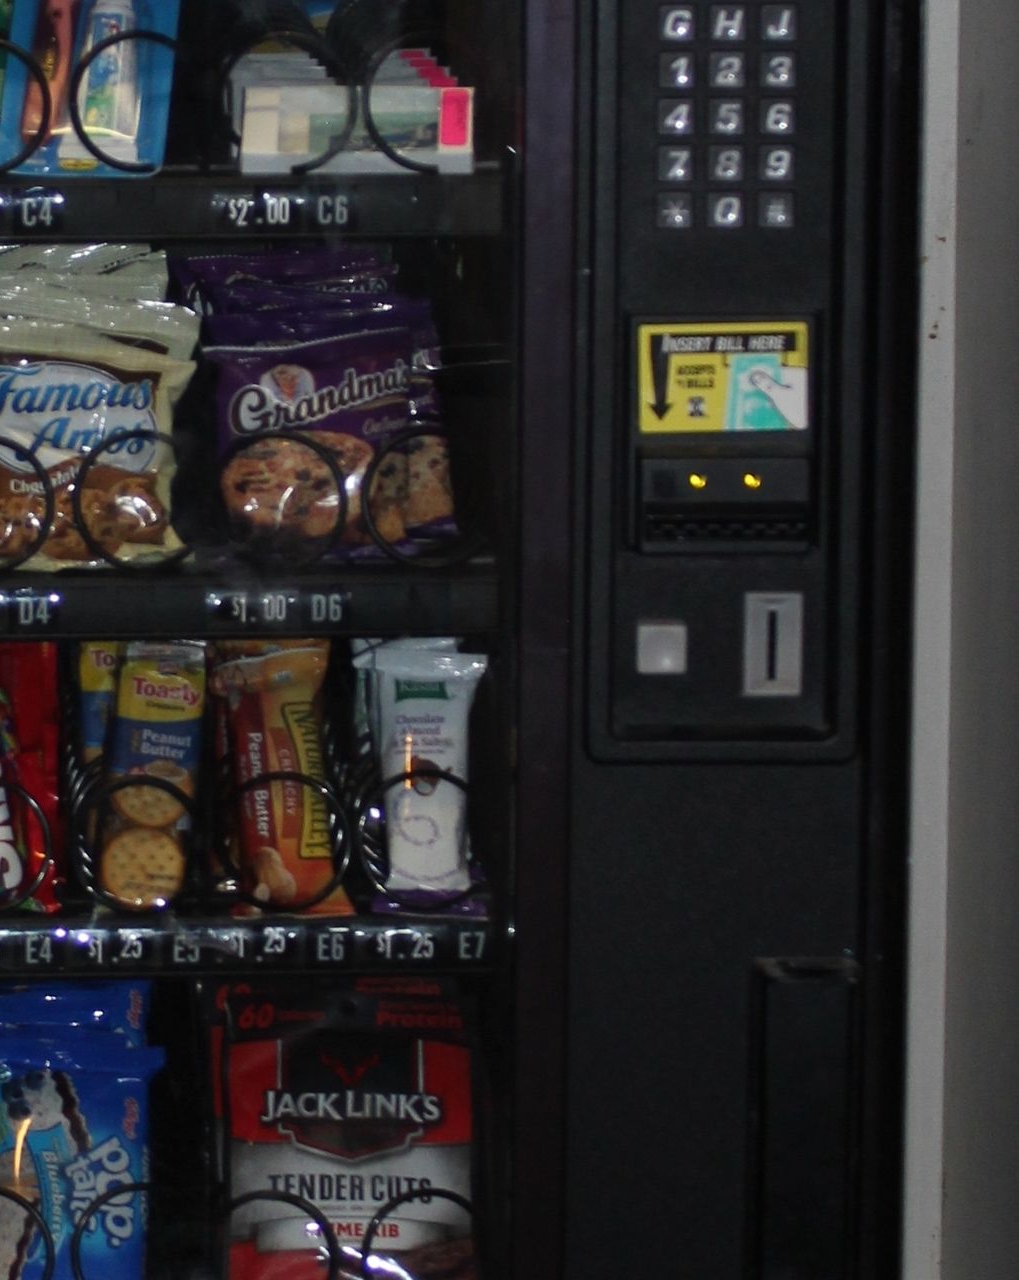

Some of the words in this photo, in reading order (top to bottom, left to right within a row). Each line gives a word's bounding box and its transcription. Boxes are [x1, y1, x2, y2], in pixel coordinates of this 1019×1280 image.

[663, 9, 693, 38] G
[713, 9, 744, 38] H
[766, 9, 792, 37] J
[670, 56, 690, 84] 1
[715, 56, 742, 85] 2
[765, 56, 792, 85] 3
[664, 104, 690, 131] 4
[715, 104, 741, 131] 5
[766, 103, 792, 132] 6
[667, 150, 691, 179] 7
[715, 149, 741, 177] 8
[765, 149, 791, 178] 9
[22, 199, 54, 227] C4
[228, 196, 290, 227] $2.00
[317, 196, 349, 224] C6
[714, 196, 741, 224] 0
[661, 333, 713, 352] INSERT
[715, 336, 745, 351] BILL
[748, 335, 787, 350] HERE
[19, 599, 50, 624] D4
[232, 595, 286, 622] $1.00
[311, 594, 342, 621] D6
[131, 675, 201, 707] Toasty
[139, 741, 188, 760] Butter
[141, 728, 193, 748] Peanut
[254, 788, 271, 840] Butter
[25, 936, 53, 964] E4
[173, 936, 201, 963] E5
[317, 933, 345, 961] E6
[377, 932, 435, 960] $1.25
[459, 932, 486, 959] E7
[260, 1090, 344, 1122] JACK
[267, 1173, 365, 1202] TENDER
[371, 1174, 432, 1204] CUTS
